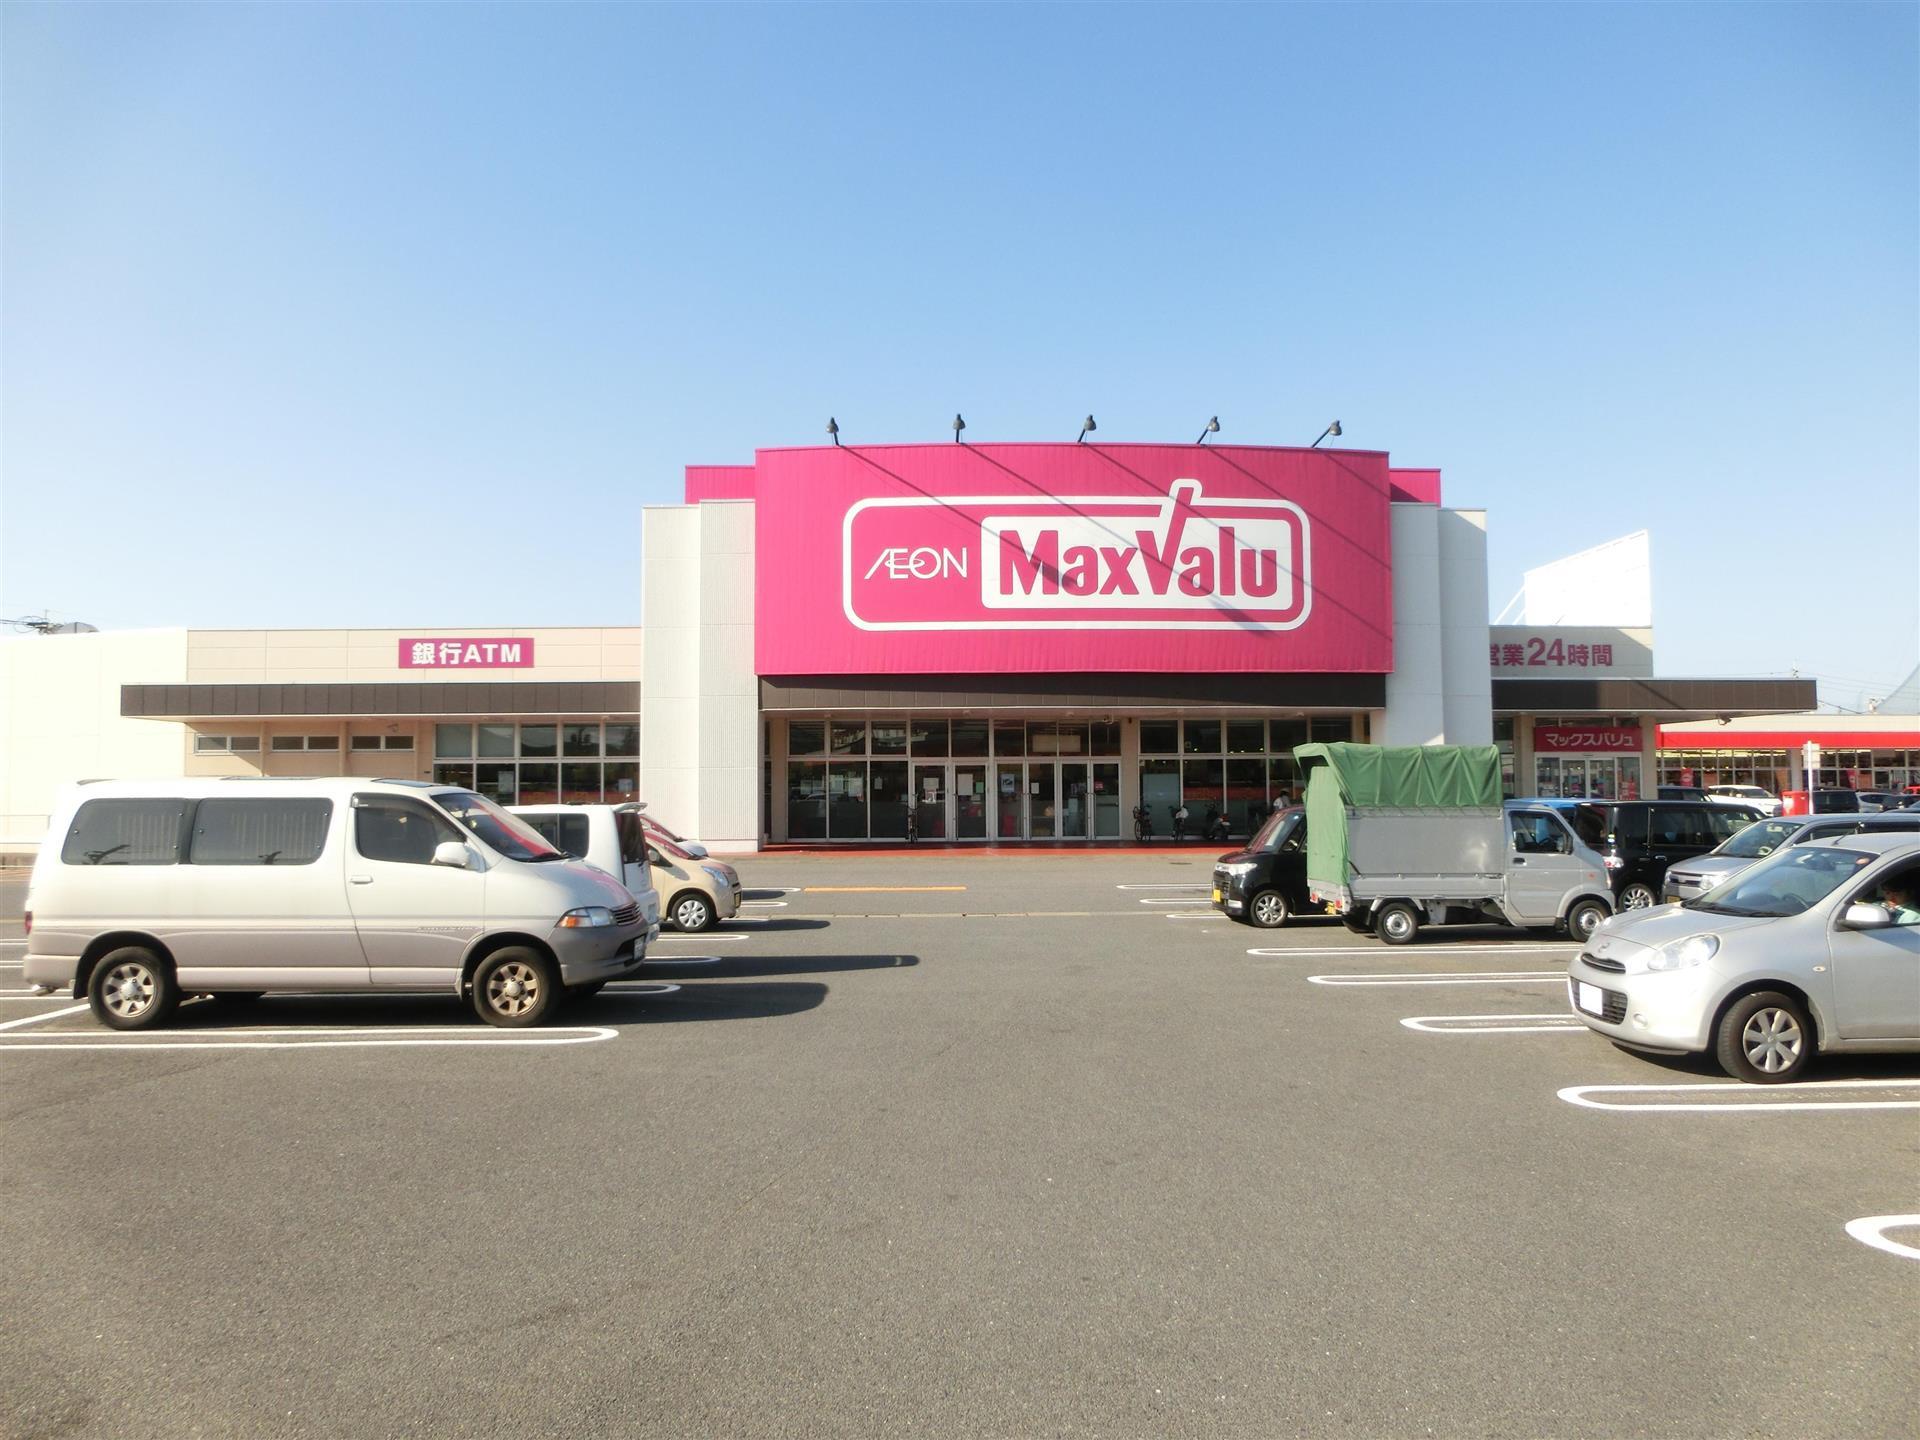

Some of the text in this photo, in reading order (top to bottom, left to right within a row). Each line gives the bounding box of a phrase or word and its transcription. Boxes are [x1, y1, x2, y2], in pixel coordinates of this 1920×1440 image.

[1000, 487, 1278, 598] MaxValu
[411, 642, 521, 665] 銀行ATM
[1545, 733, 1635, 747] マックスバリュ
